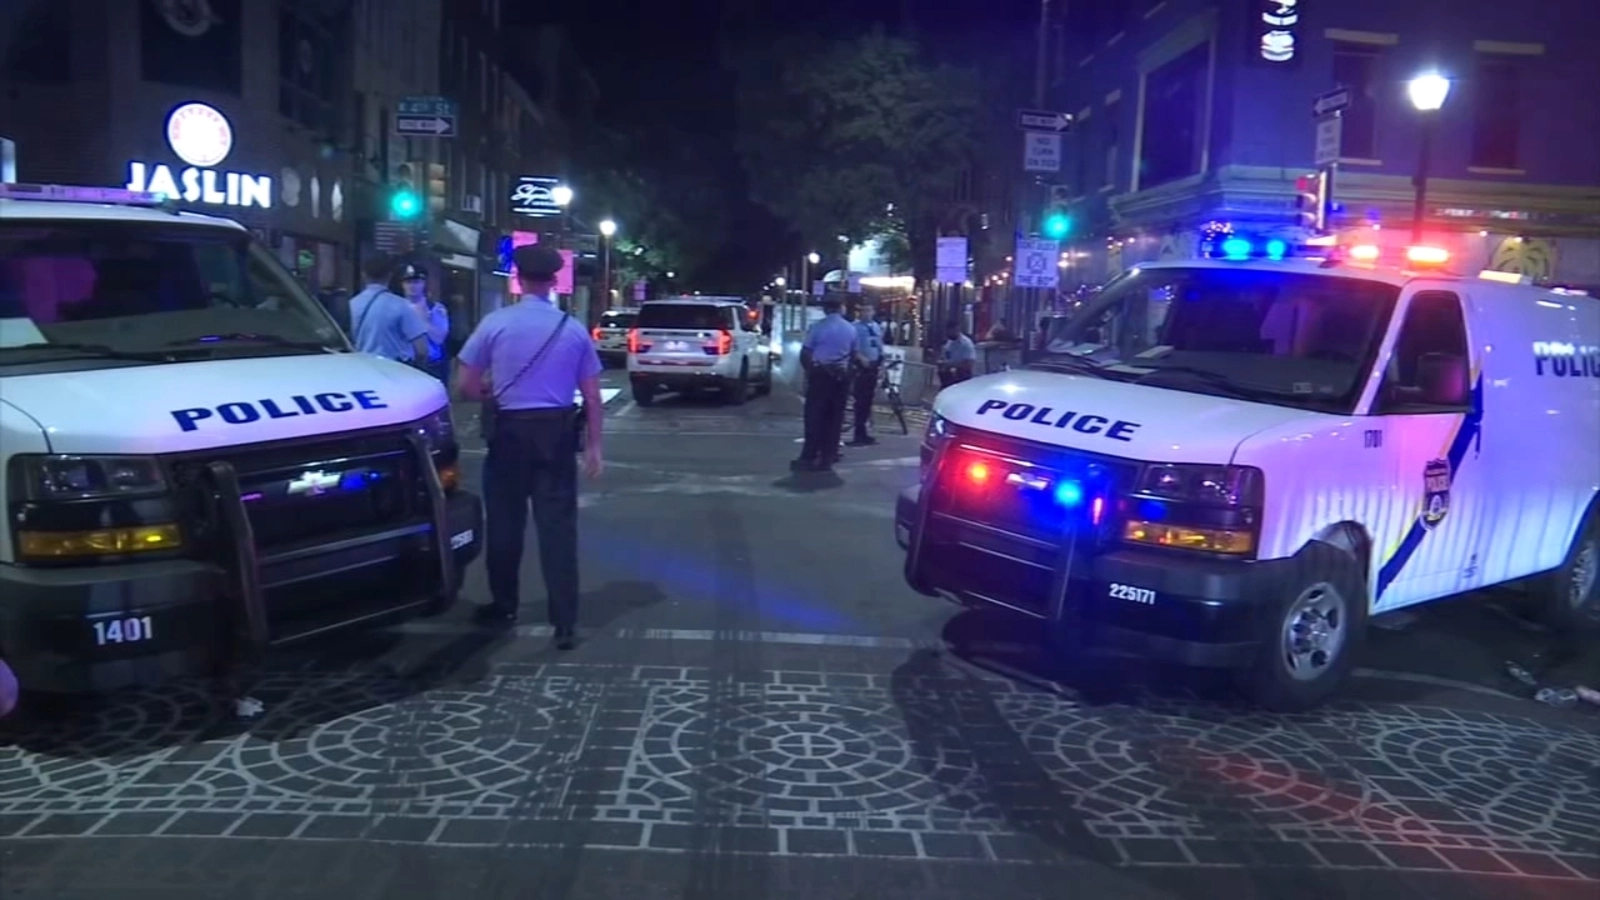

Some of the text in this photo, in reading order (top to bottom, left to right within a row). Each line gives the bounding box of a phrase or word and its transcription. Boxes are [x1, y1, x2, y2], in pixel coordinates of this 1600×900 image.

[127, 161, 271, 208] JASLIN
[170, 390, 388, 432] POLICE
[976, 399, 1142, 442] POLICE
[1364, 429, 1382, 448] 1701
[1109, 583, 1156, 605] 225171
[93, 616, 152, 645] 1401
